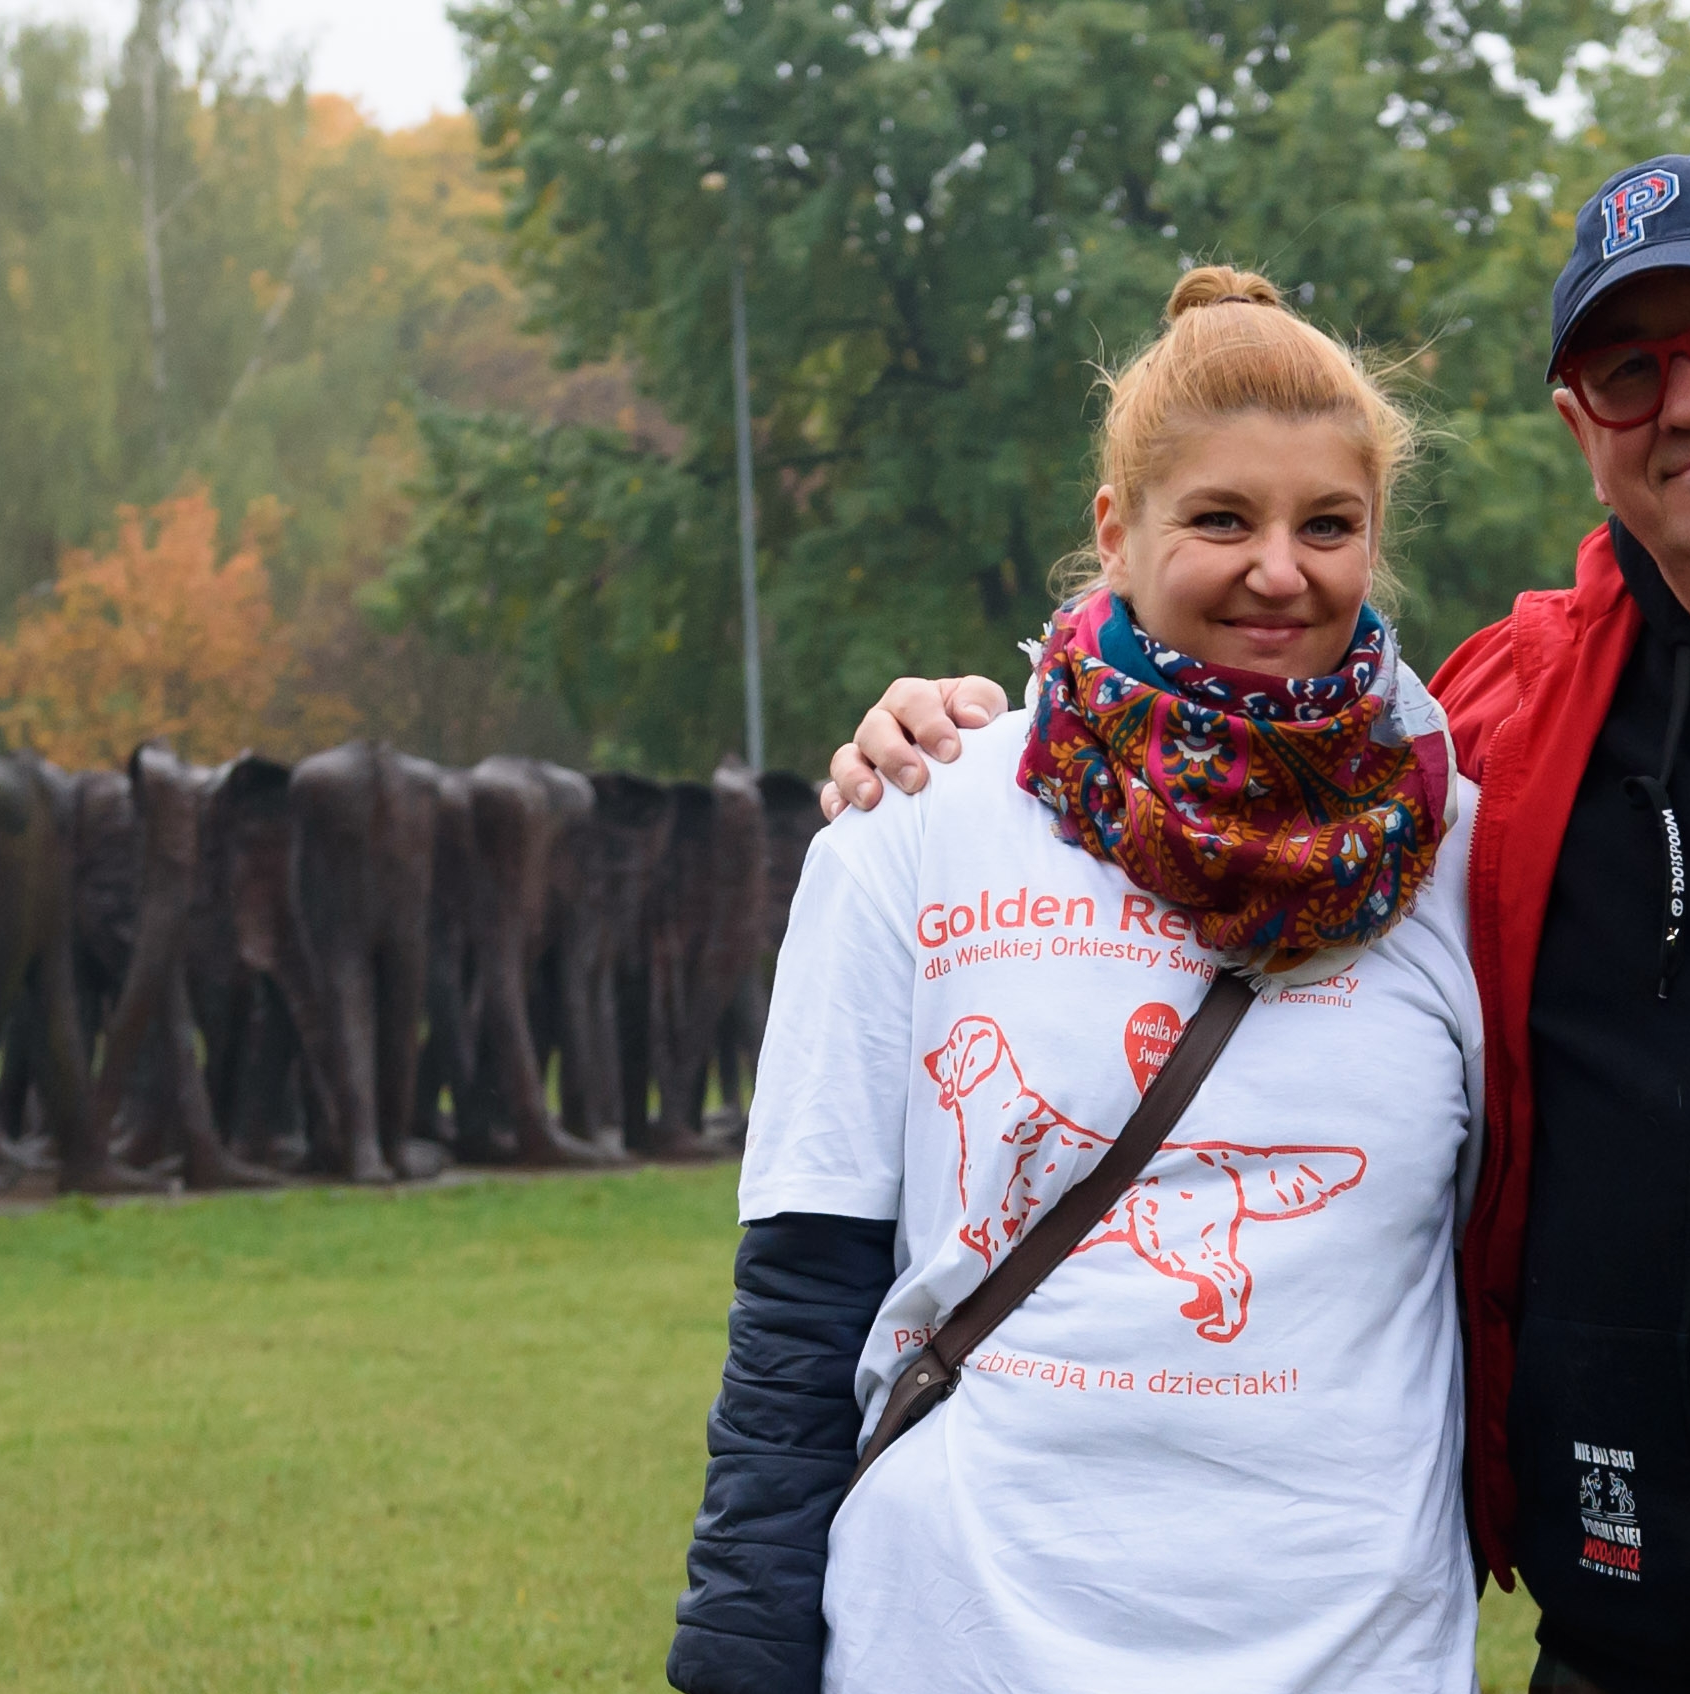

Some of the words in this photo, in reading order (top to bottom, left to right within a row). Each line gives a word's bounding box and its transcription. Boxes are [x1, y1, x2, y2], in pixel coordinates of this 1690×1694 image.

[1601, 168, 1680, 260] P
[1662, 808, 1685, 896] woodstock
[916, 887, 1096, 948] Golden
[924, 956, 951, 980] dla
[955, 937, 1042, 967] Wielkiej
[1051, 936, 1161, 968] Orkiestry
[1316, 976, 1359, 993] ocy
[1132, 1016, 1170, 1041] wielka
[1279, 991, 1352, 1008] Poznaniu
[894, 1322, 938, 1353] Psi
[976, 1351, 1087, 1391] zbierają
[1098, 1369, 1135, 1391] na
[1148, 1368, 1299, 1396] dzieciaki!
[1574, 1441, 1591, 1462] NIE
